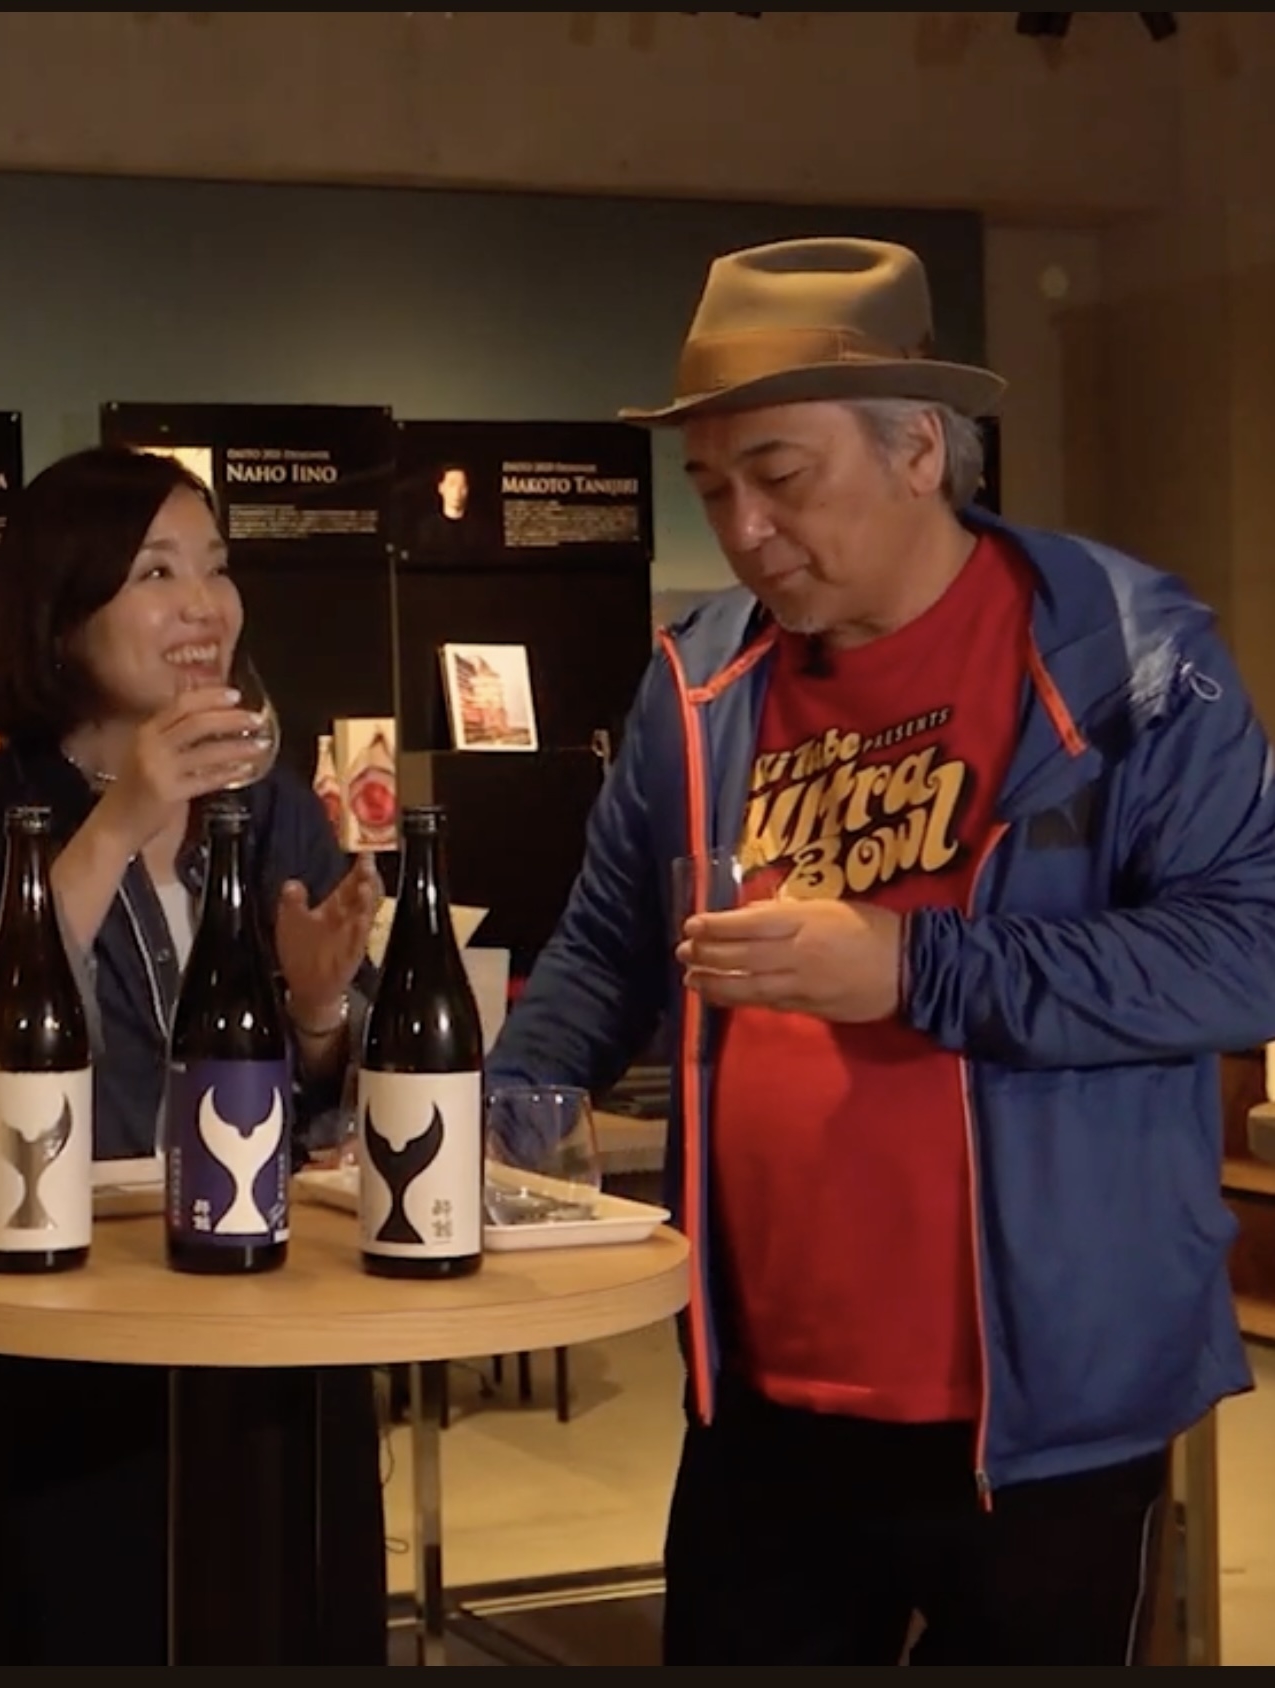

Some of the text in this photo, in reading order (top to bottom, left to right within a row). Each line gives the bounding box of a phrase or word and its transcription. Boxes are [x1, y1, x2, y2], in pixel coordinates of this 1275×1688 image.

[226, 462, 338, 483] NAHO IINO
[862, 707, 950, 753] PRESENTS
